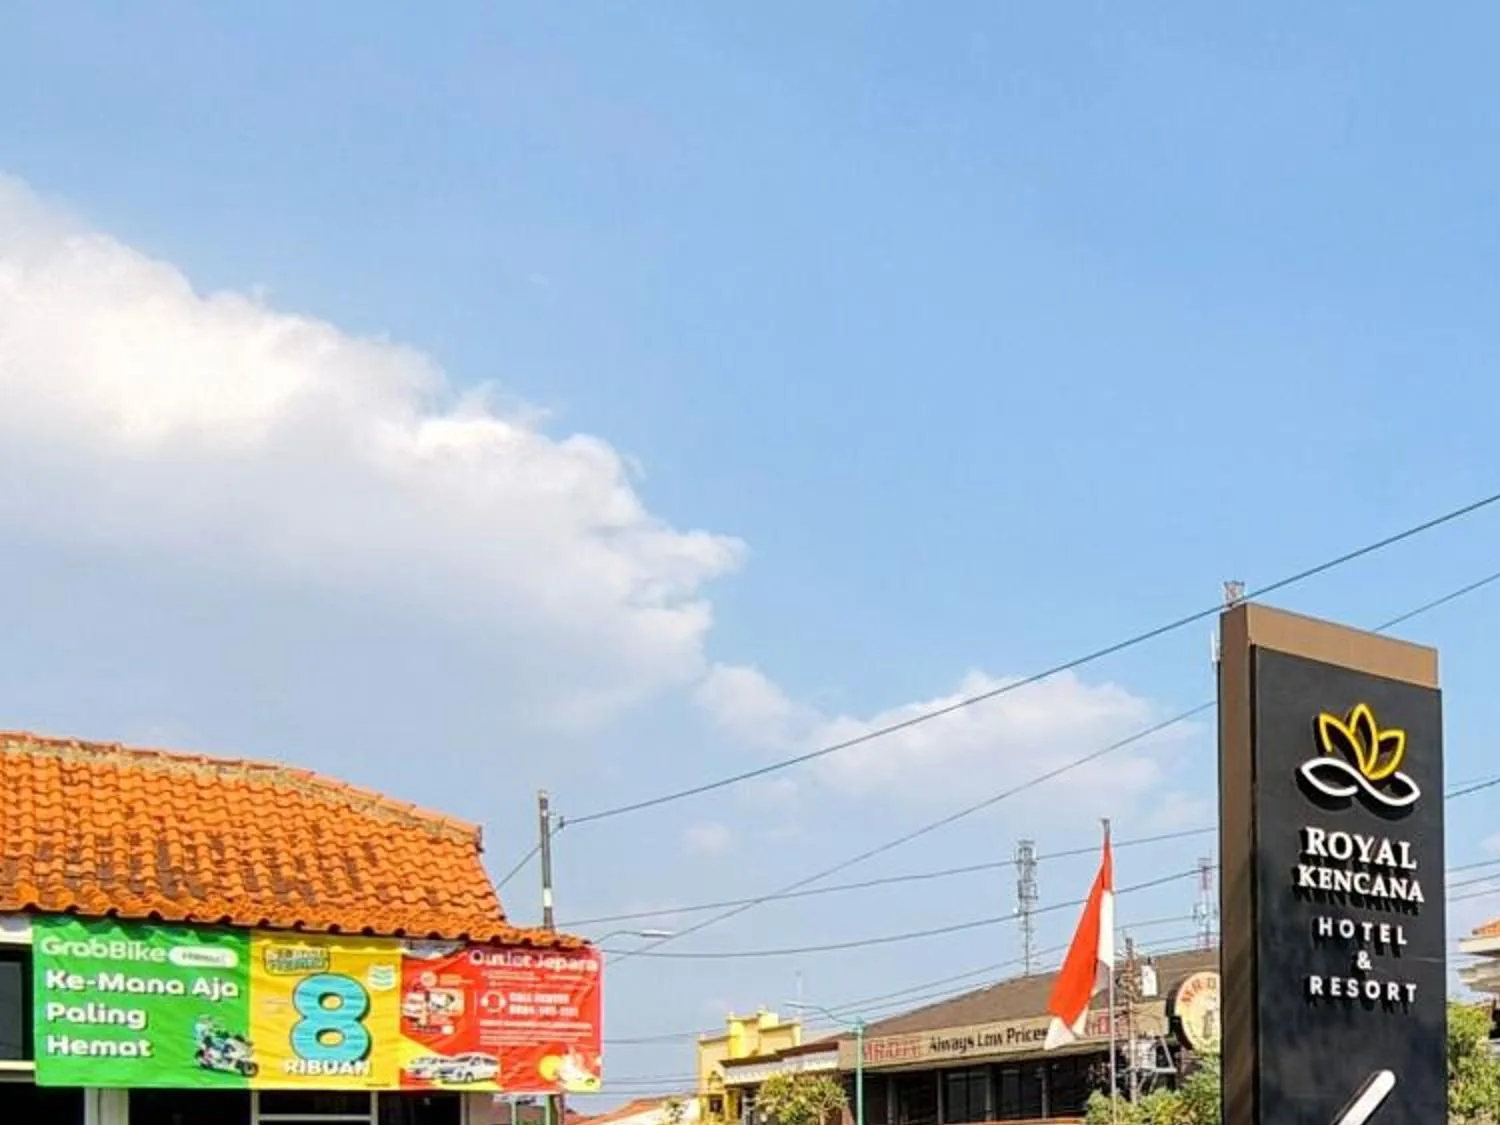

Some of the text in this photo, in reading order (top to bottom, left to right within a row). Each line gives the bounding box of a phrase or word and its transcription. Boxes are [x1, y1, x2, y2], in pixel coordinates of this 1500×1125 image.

[1306, 826, 1417, 869] ROYAL
[1298, 864, 1425, 902] KENCANA
[1318, 916, 1408, 945] HOTEL
[41, 935, 166, 963] GrabBike
[1356, 950, 1373, 970] &
[46, 969, 240, 1002] Ke-Mana Aja
[1309, 975, 1417, 1003] RESORT
[46, 1001, 149, 1030] Paling
[289, 972, 373, 1064] 8
[46, 1034, 153, 1058] Hemat
[930, 1034, 975, 1056] Always
[978, 1030, 1004, 1048] Low
[1007, 1026, 1048, 1046] Prices
[283, 1058, 371, 1077] RIBUAN
